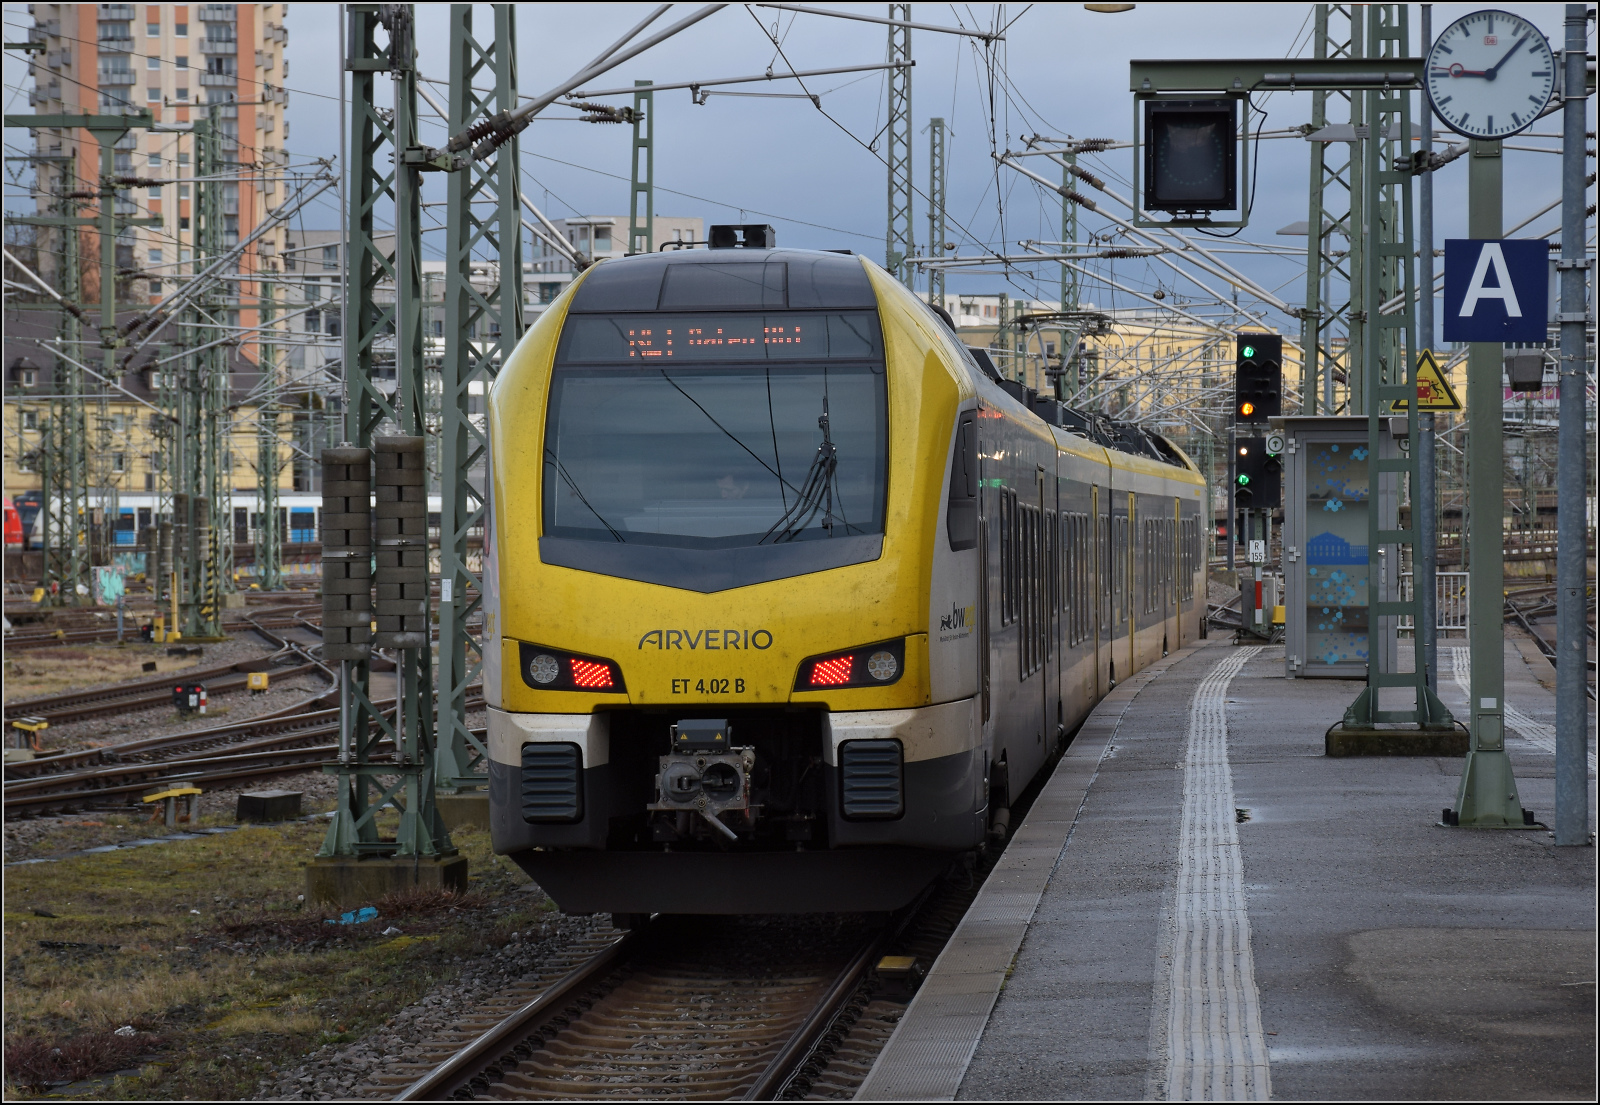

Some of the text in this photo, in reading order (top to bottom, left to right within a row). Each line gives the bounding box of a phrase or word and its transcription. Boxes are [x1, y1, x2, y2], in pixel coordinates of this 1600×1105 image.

[1458, 242, 1523, 318] A
[1254, 542, 1260, 550] R
[638, 629, 773, 650] ARVERIO
[671, 678, 746, 694] ET 4.02 B
